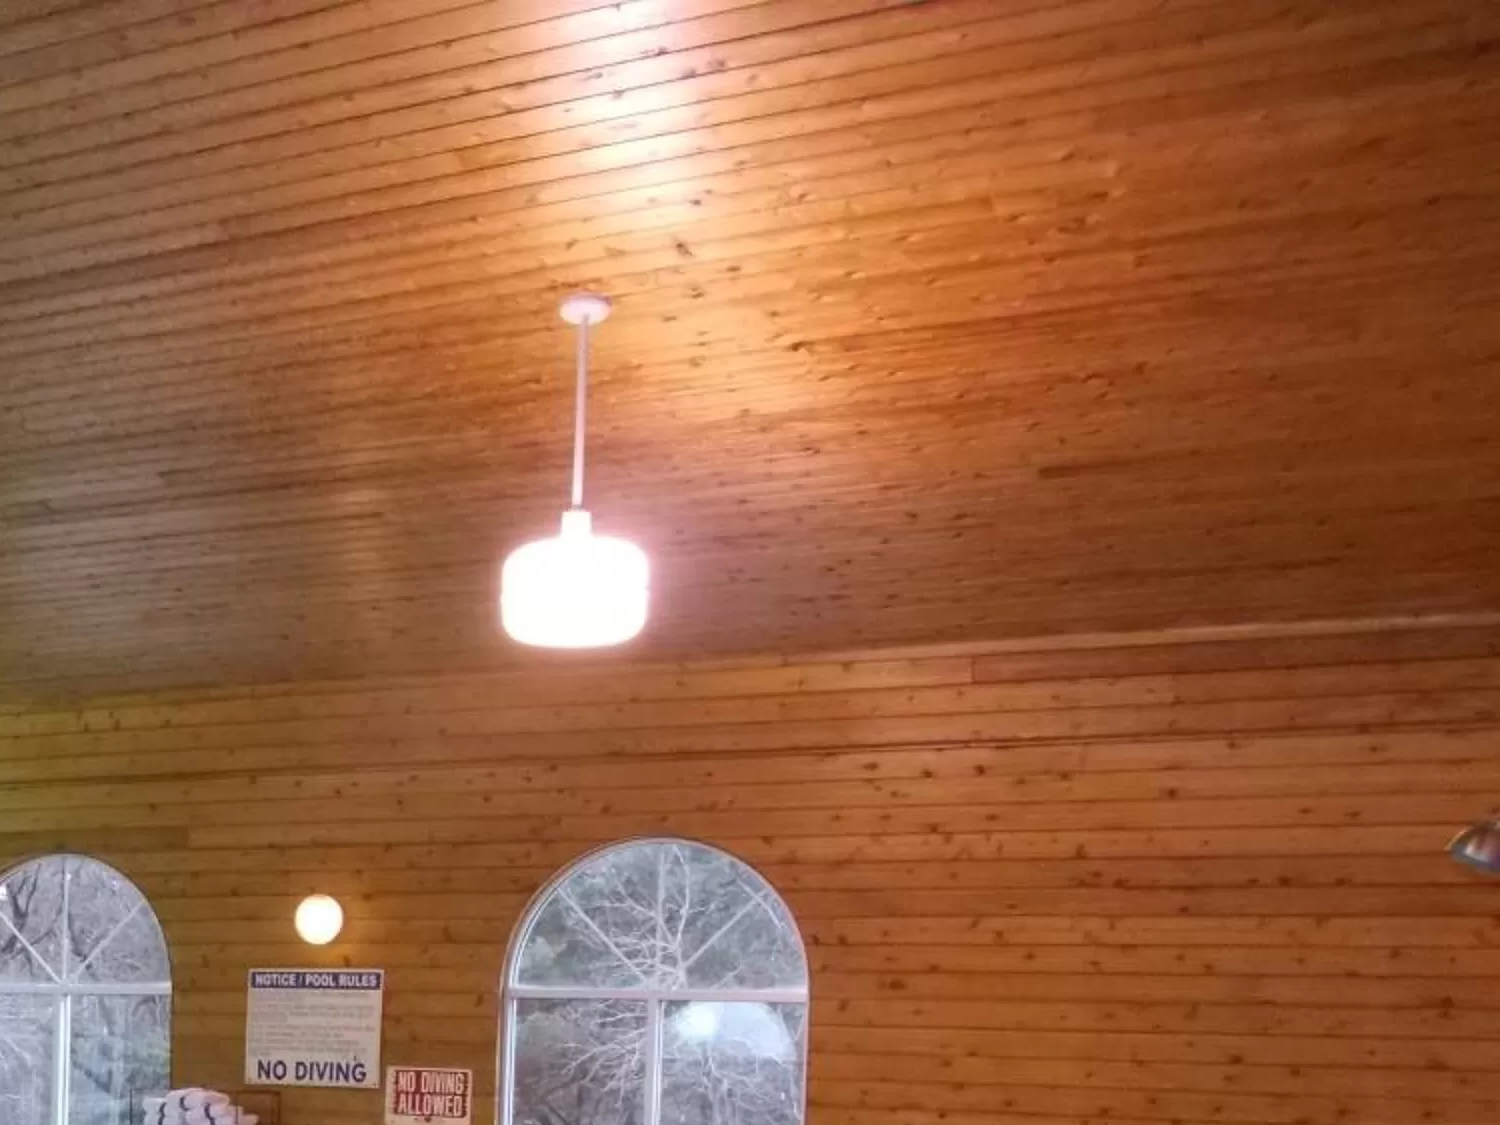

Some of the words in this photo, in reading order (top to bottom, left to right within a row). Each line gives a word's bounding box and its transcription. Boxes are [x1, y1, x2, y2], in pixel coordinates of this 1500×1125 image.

[255, 974, 297, 987] NOTICE
[305, 974, 336, 987] POOL
[338, 974, 378, 988] RULES
[257, 1060, 287, 1081] NO
[295, 1061, 367, 1083] DIVING
[398, 1072, 415, 1093] NO
[421, 1072, 465, 1095] DIVING
[398, 1094, 463, 1116] ALLOWED
